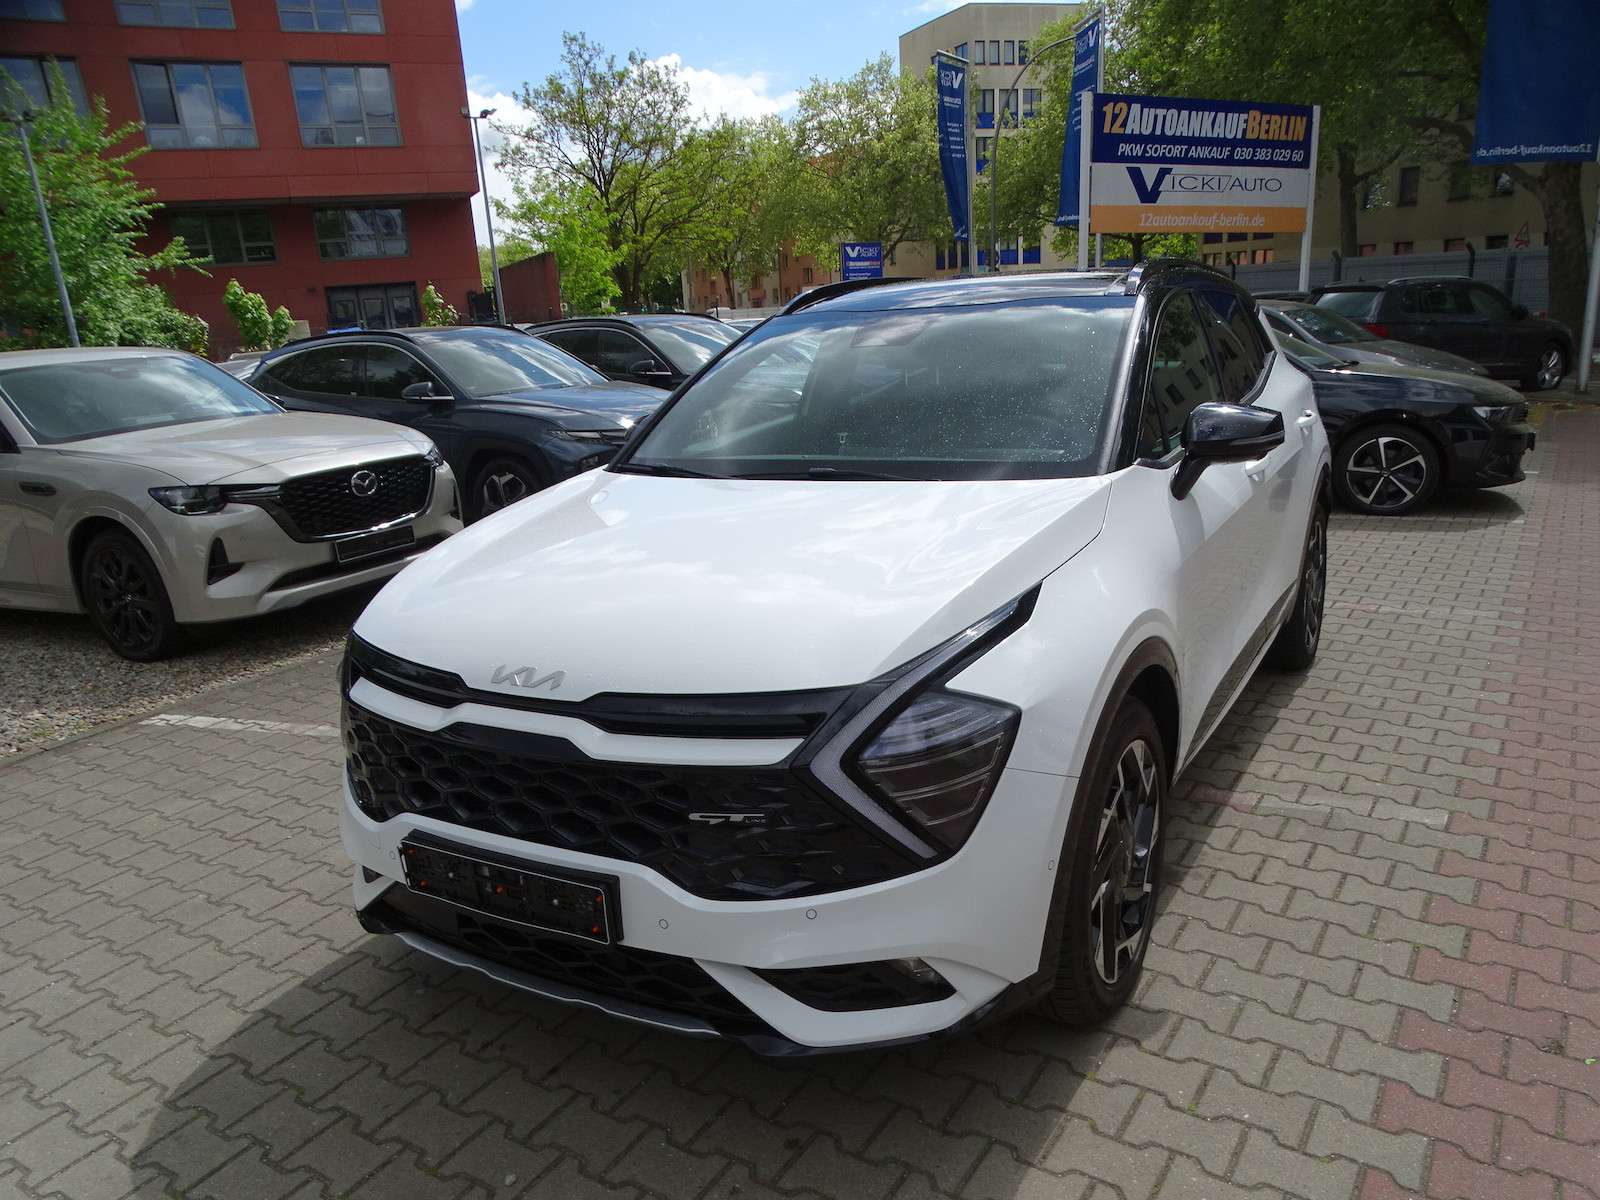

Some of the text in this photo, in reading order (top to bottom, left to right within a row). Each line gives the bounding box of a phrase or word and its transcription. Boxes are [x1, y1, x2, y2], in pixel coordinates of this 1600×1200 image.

[1118, 143, 1304, 162] PKW SOFORT ANKAUF 030 383 029 60
[1139, 212, 1265, 229] 12autoankauf-berlin.de
